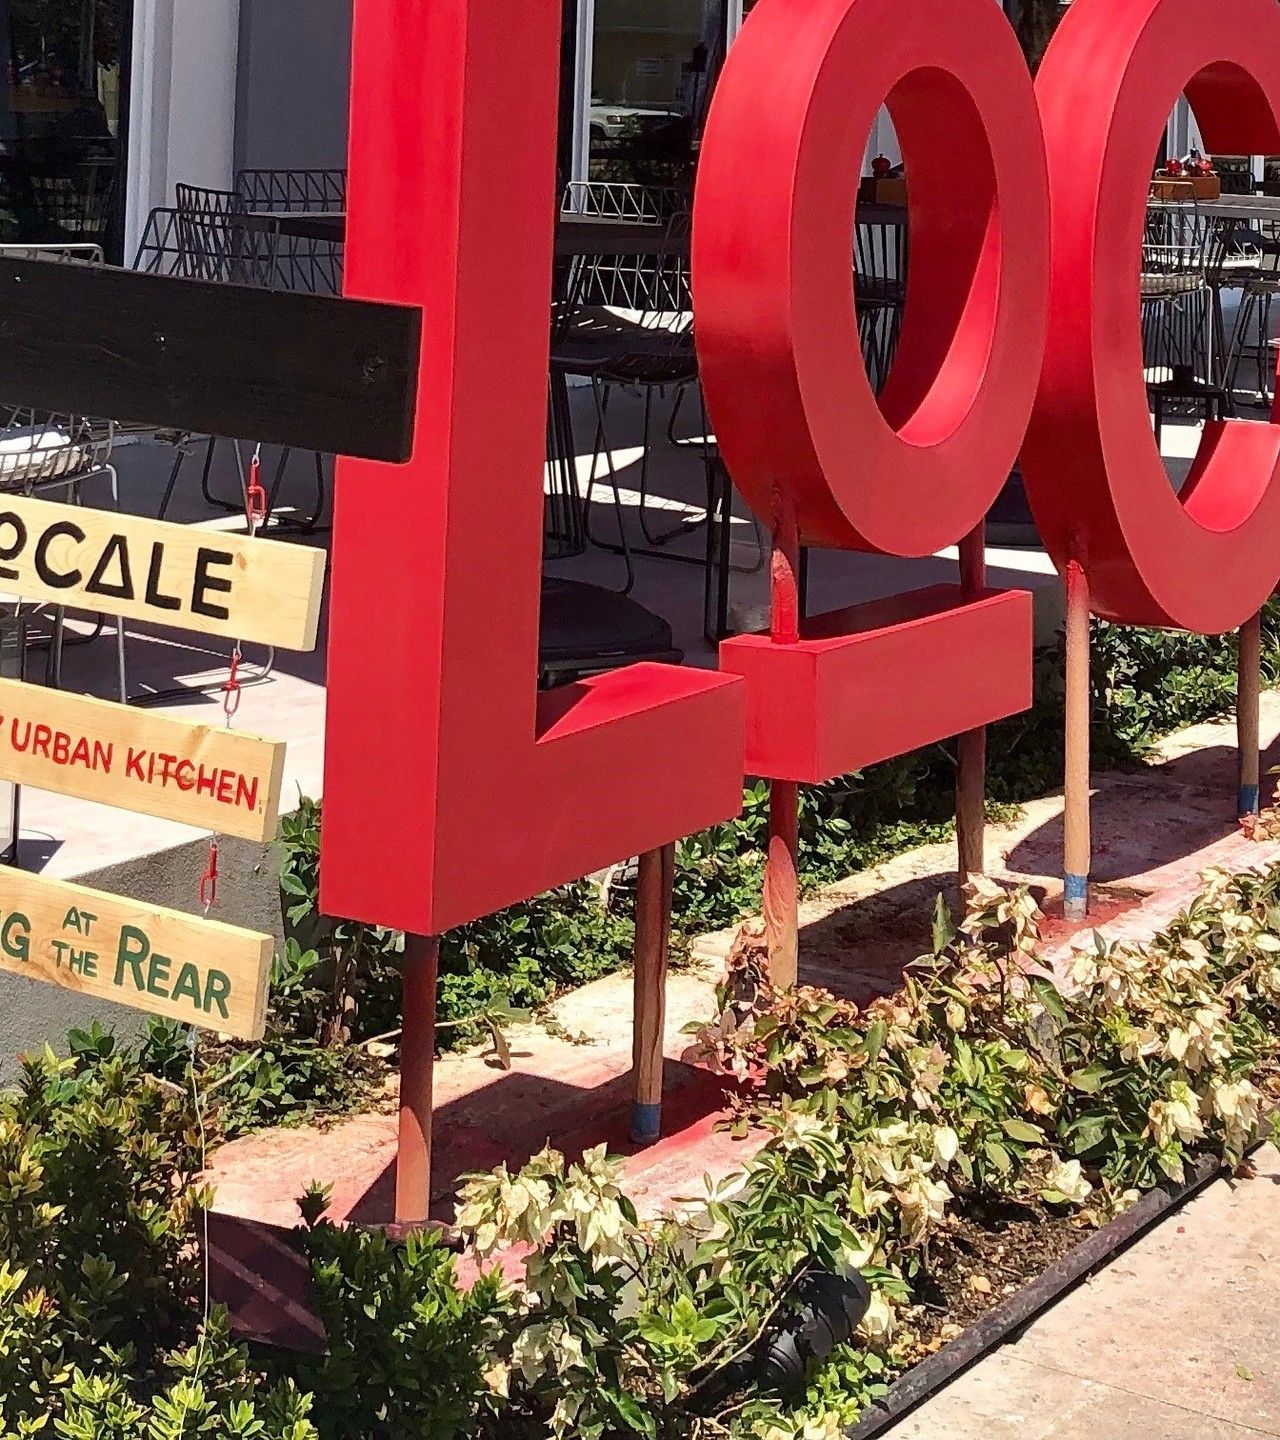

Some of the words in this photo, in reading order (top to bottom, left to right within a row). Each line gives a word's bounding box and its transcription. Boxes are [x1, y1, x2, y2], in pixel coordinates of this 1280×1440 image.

[10, 717, 114, 774] URBAN
[125, 747, 260, 812] KITCHEN
[62, 906, 98, 938] AT
[51, 939, 99, 979] THE
[114, 925, 233, 1020] REAR
